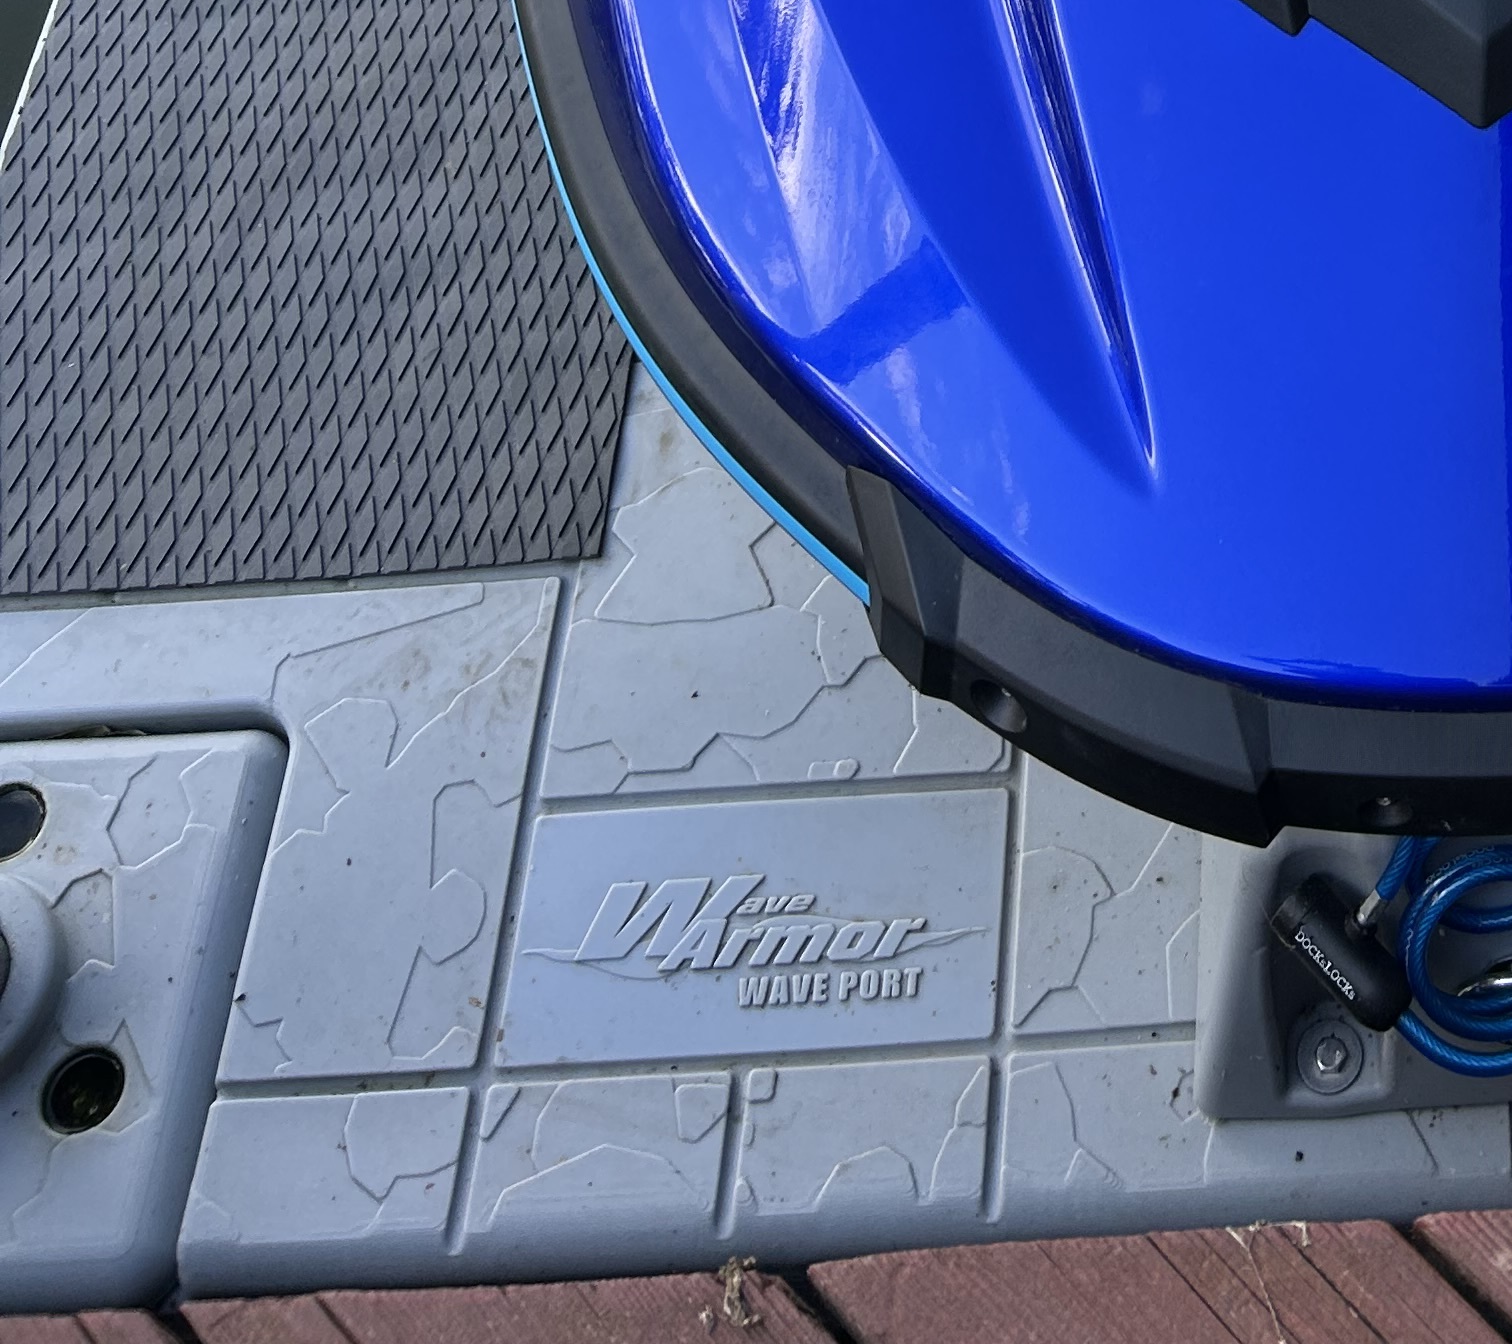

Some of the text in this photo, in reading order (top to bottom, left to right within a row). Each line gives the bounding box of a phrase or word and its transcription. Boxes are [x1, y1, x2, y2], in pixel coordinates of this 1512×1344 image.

[657, 916, 928, 972] Armor
[738, 966, 924, 1009] WAVE PORT
